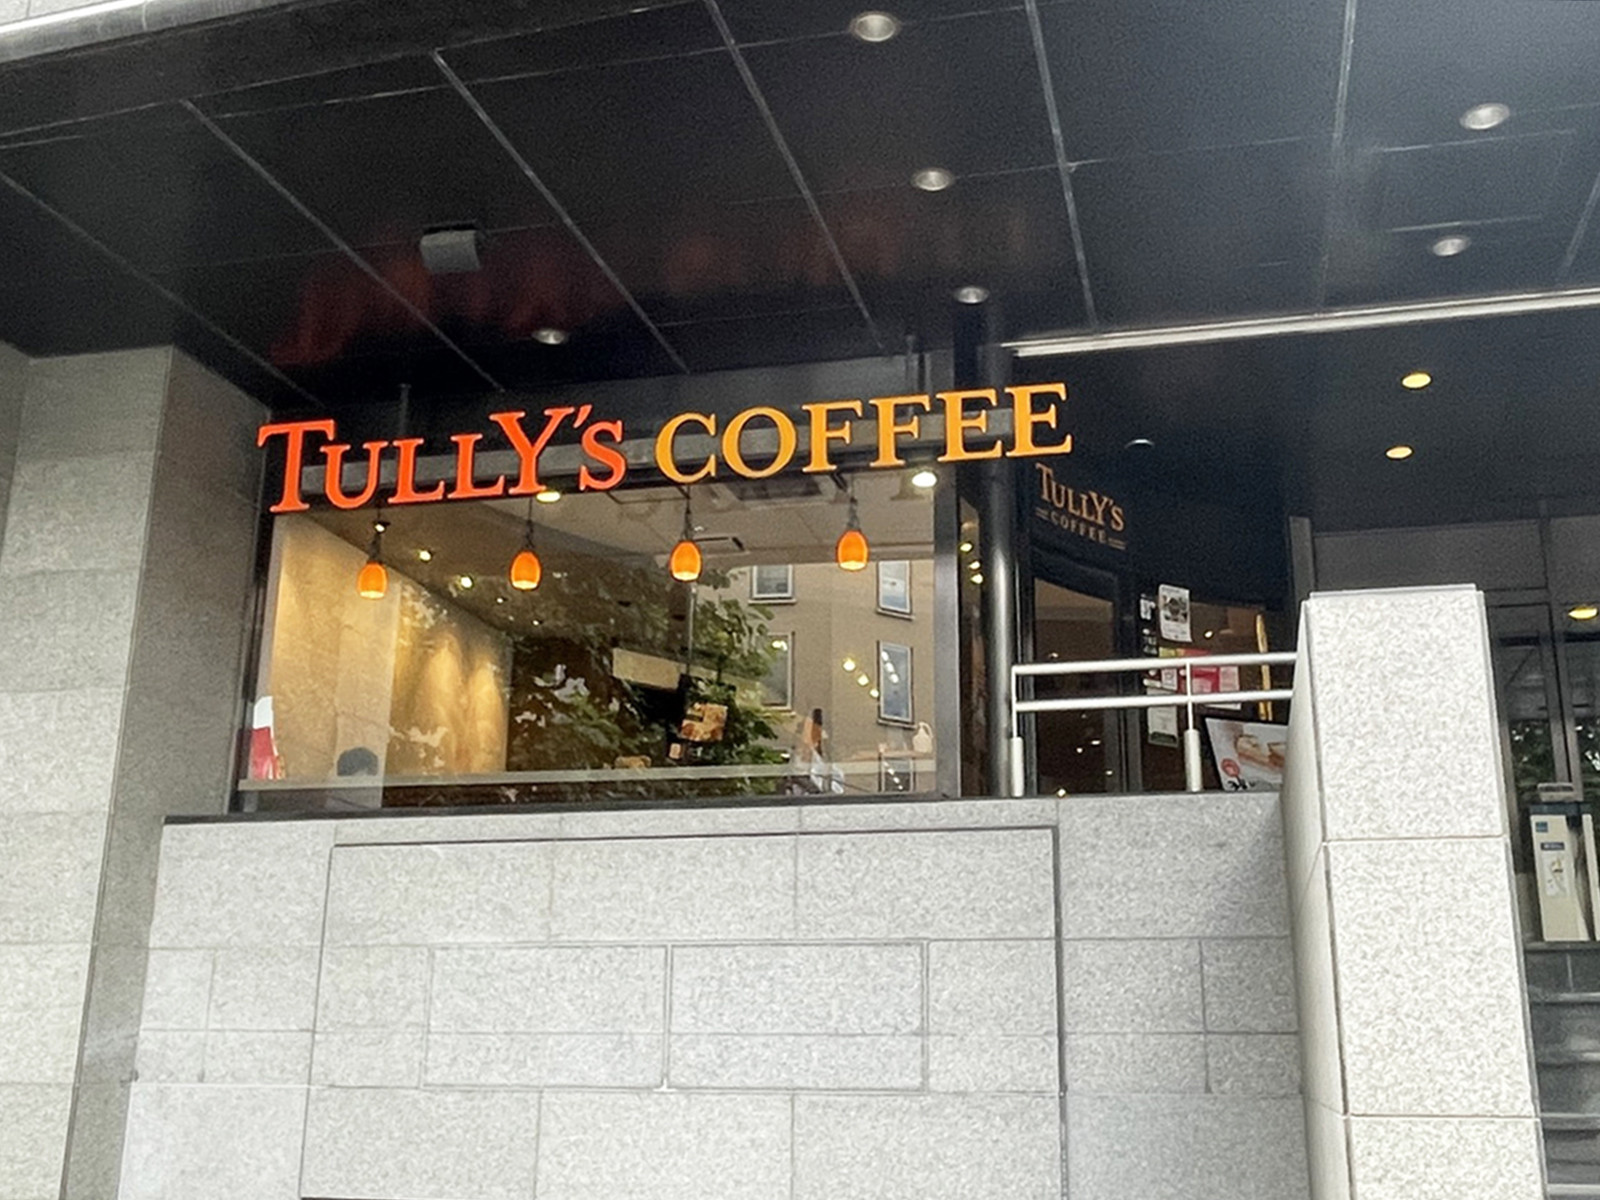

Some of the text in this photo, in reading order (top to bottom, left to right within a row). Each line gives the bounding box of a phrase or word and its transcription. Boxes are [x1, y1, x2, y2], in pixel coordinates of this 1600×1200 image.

[655, 383, 1072, 483] COFFEE
[1035, 462, 1125, 532] TULLY'S
[1050, 510, 1107, 545] COFFEE
